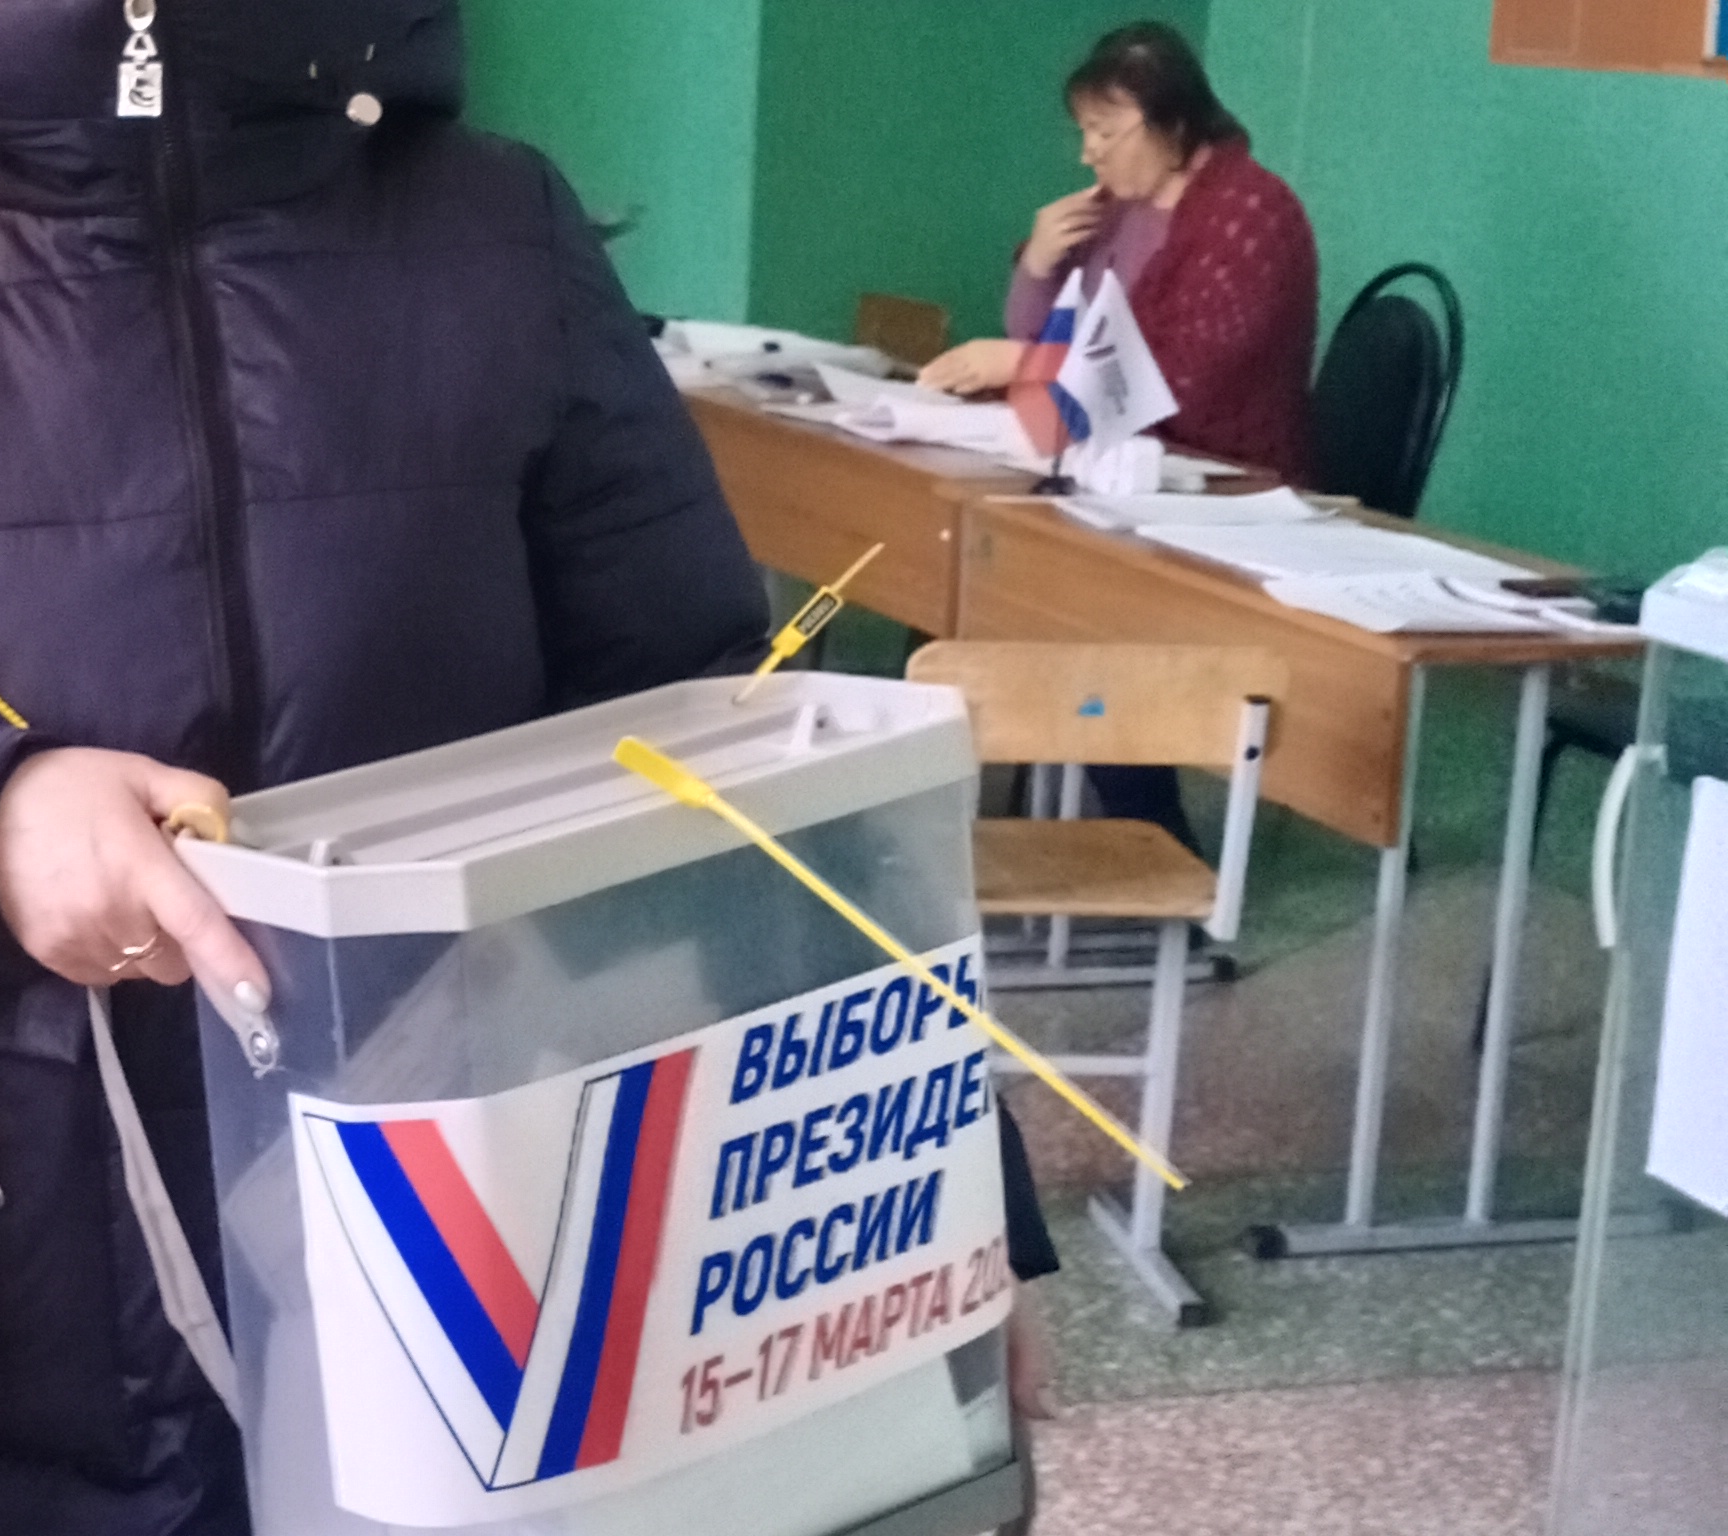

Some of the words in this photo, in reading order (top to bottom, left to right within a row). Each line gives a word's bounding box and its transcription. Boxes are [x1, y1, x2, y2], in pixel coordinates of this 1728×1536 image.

[709, 1048, 989, 1220] ПРЕЗИДЕ
[690, 1169, 943, 1336] РОССИИ
[808, 1263, 953, 1381] МАРТА
[959, 1235, 1008, 1316] 20
